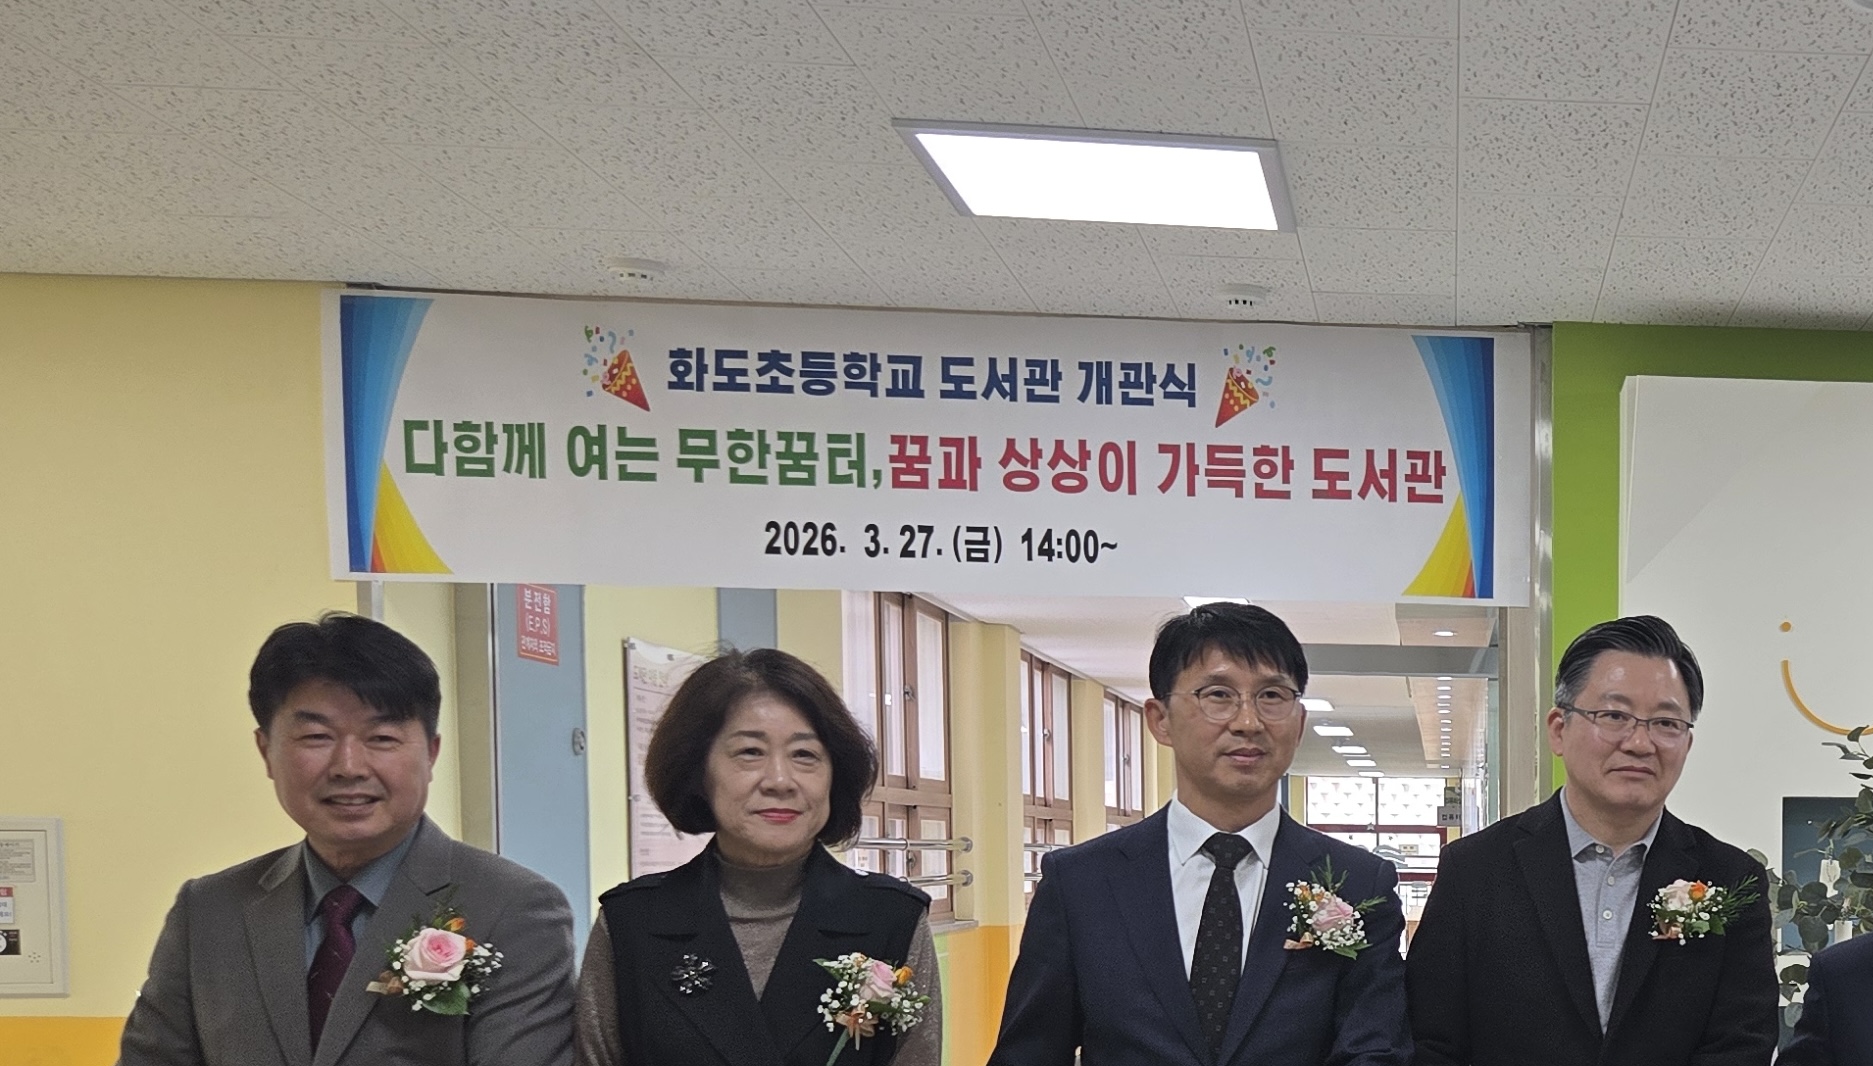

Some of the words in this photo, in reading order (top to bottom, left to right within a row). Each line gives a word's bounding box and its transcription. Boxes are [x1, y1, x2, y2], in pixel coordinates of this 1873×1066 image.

[667, 347, 925, 399] 화도초등학교
[939, 356, 1063, 403] 도서관
[1077, 360, 1197, 408] 개관식
[402, 420, 547, 480] 다함께
[566, 424, 660, 482] 여는
[998, 437, 1138, 496] 상상이
[1157, 441, 1295, 500] 가득한
[1311, 447, 1448, 504] 도서관
[764, 520, 846, 556] 2026.
[1020, 527, 1118, 564] 14:00~
